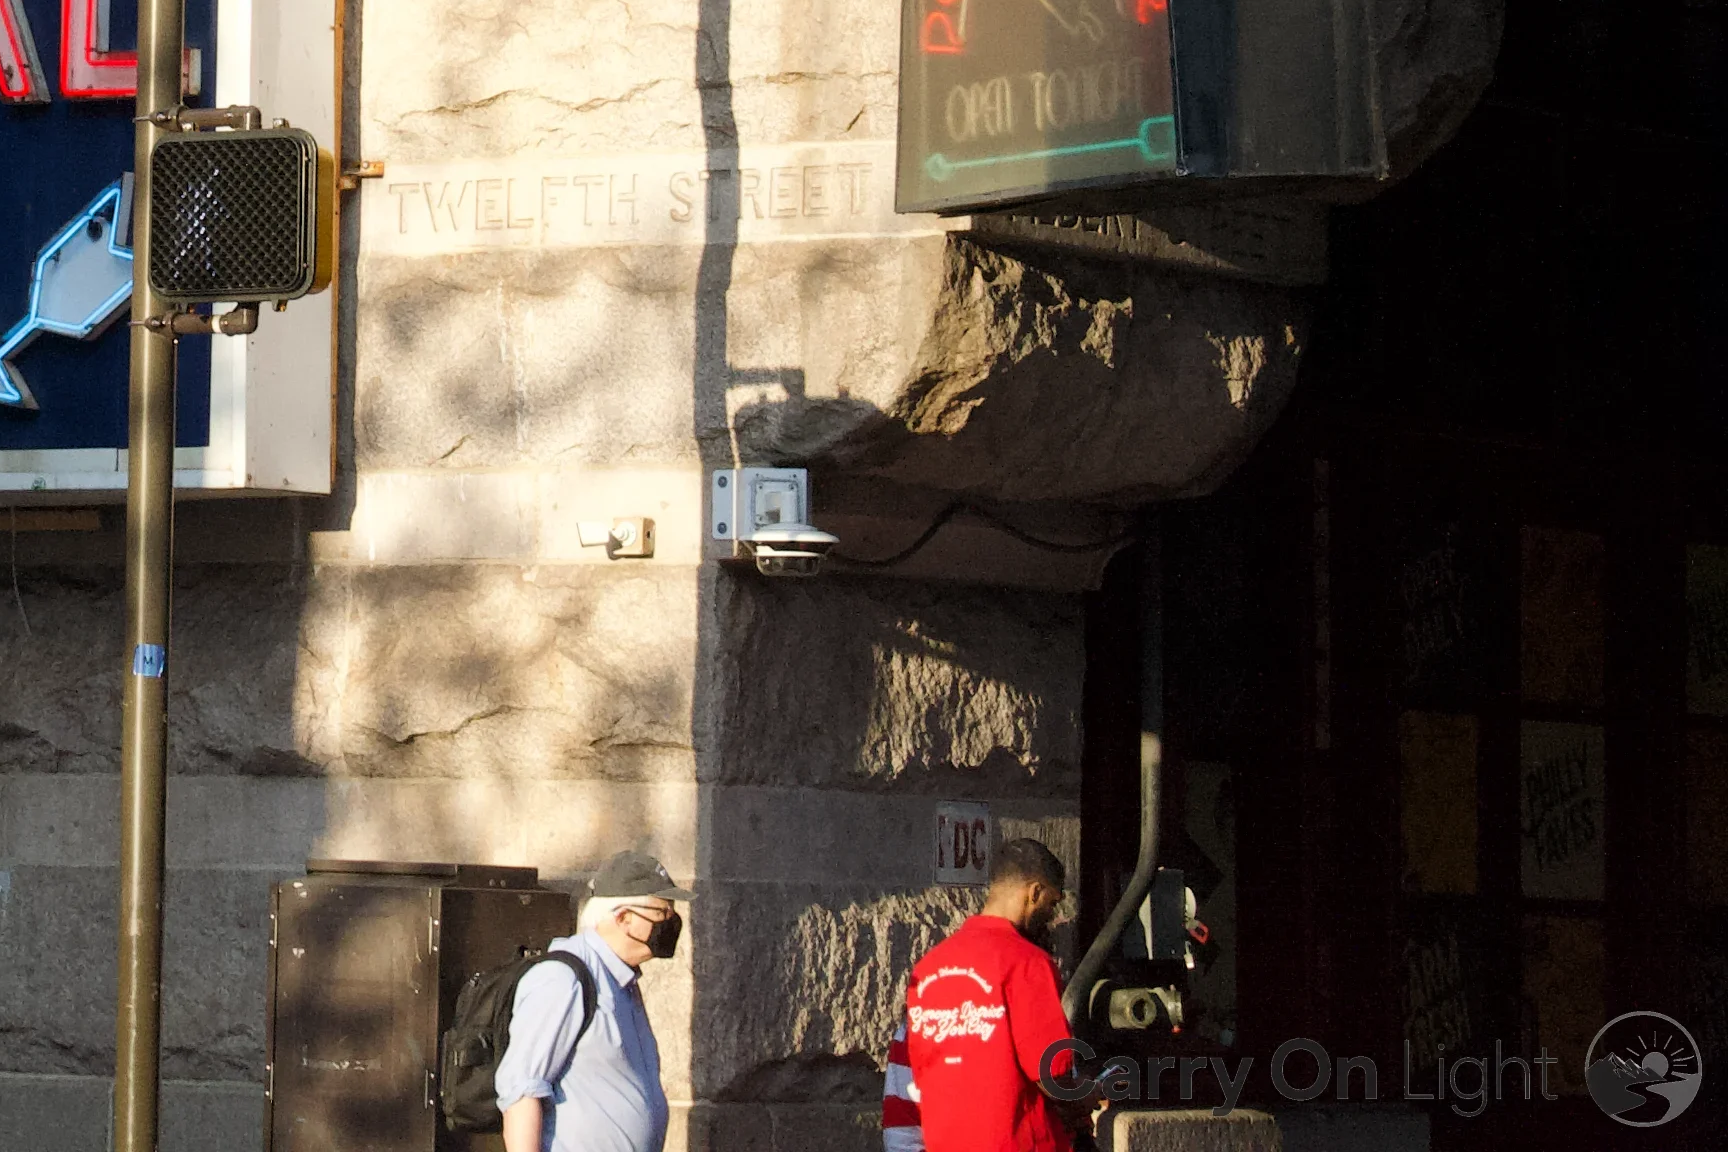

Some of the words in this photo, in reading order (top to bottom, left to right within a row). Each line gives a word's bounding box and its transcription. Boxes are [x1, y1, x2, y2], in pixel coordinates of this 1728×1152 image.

[945, 75, 1013, 144] OPEN
[388, 173, 640, 235] TWELFTH
[669, 162, 874, 223] STREET
